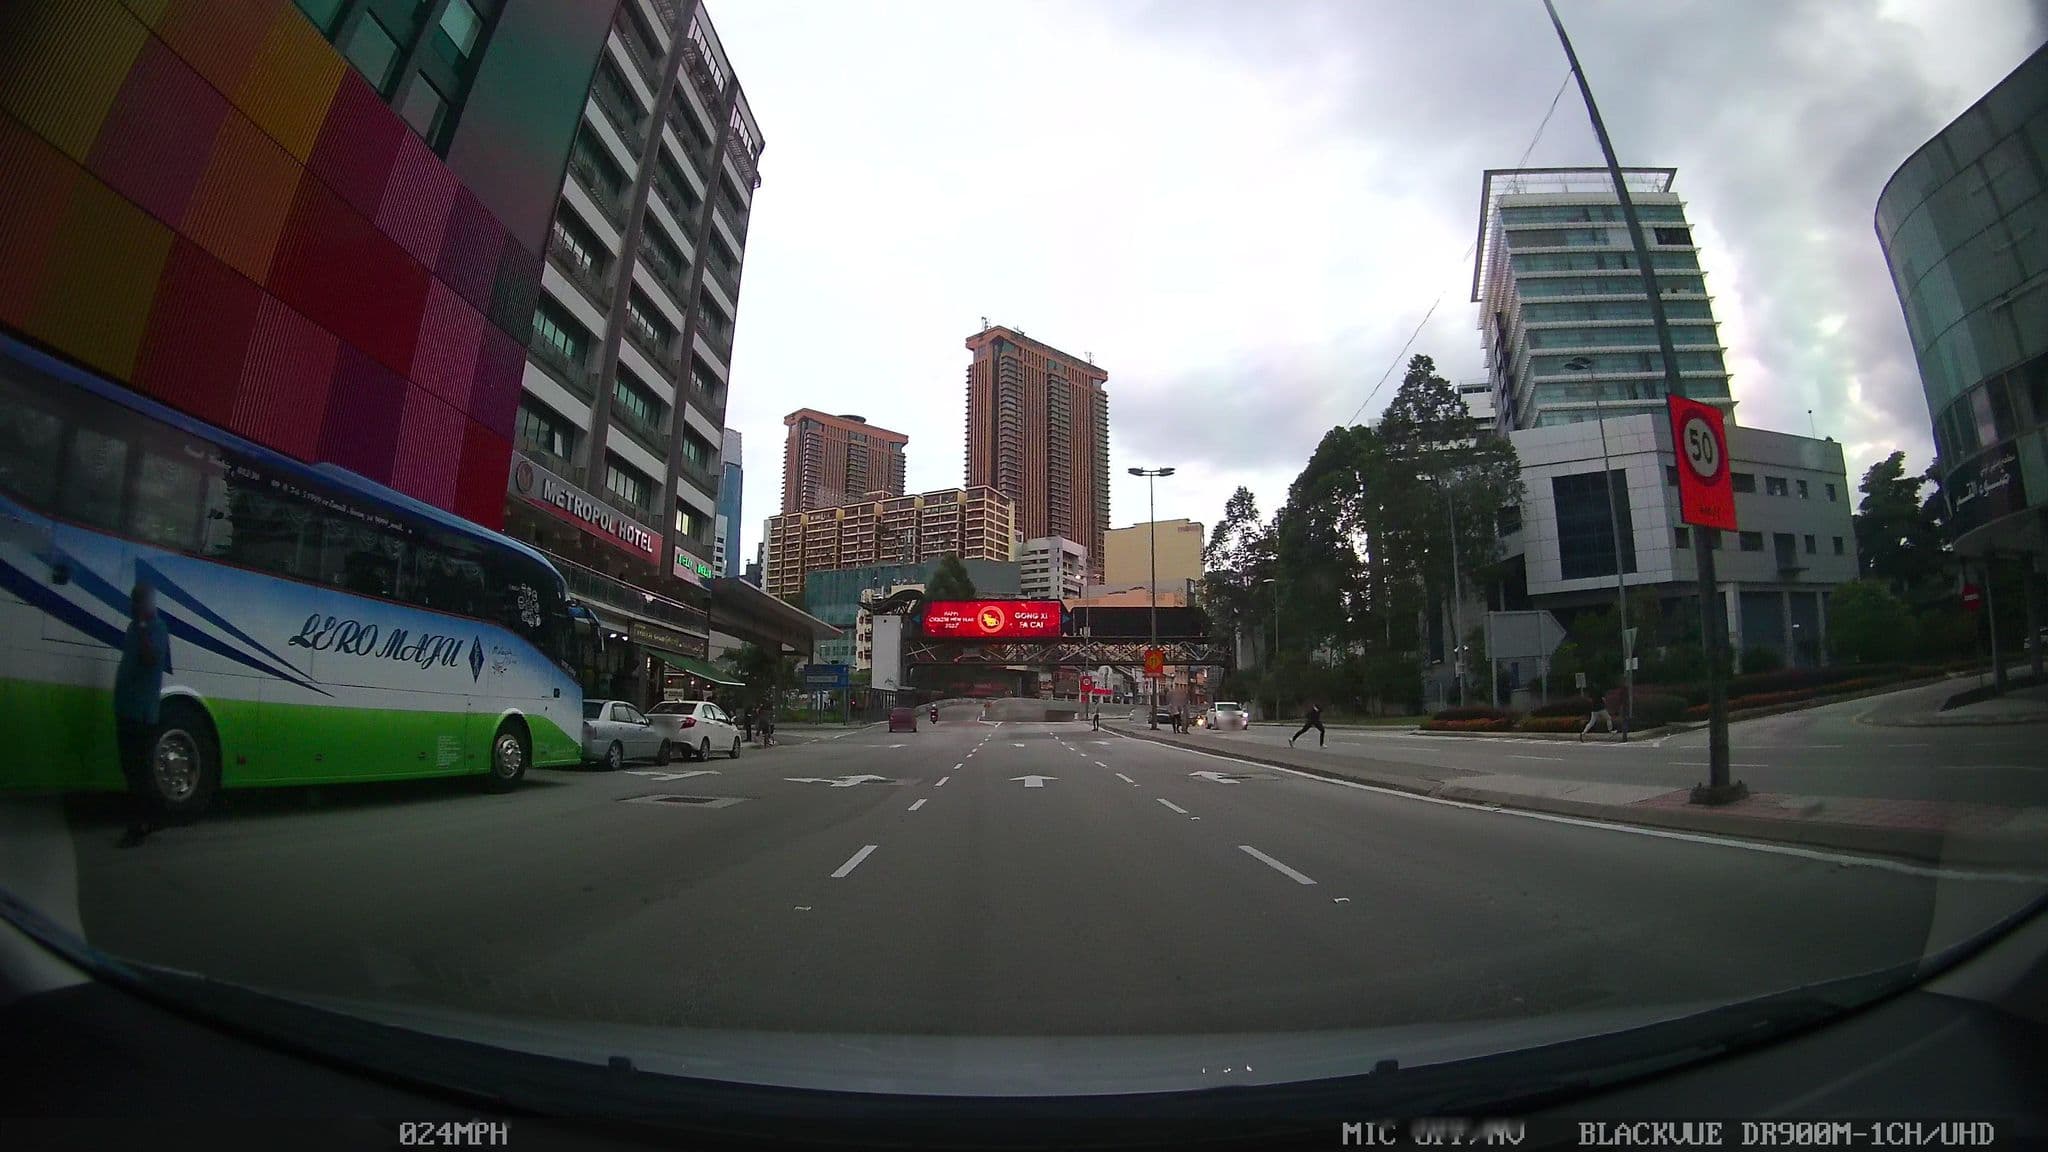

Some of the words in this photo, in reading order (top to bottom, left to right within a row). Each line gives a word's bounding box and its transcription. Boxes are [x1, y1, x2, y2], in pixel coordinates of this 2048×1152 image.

[1689, 429, 1713, 464] 50
[544, 479, 616, 534] METROPOL
[619, 520, 653, 553] HOTEL
[288, 613, 378, 656] LERO
[376, 628, 464, 670] MAJU
